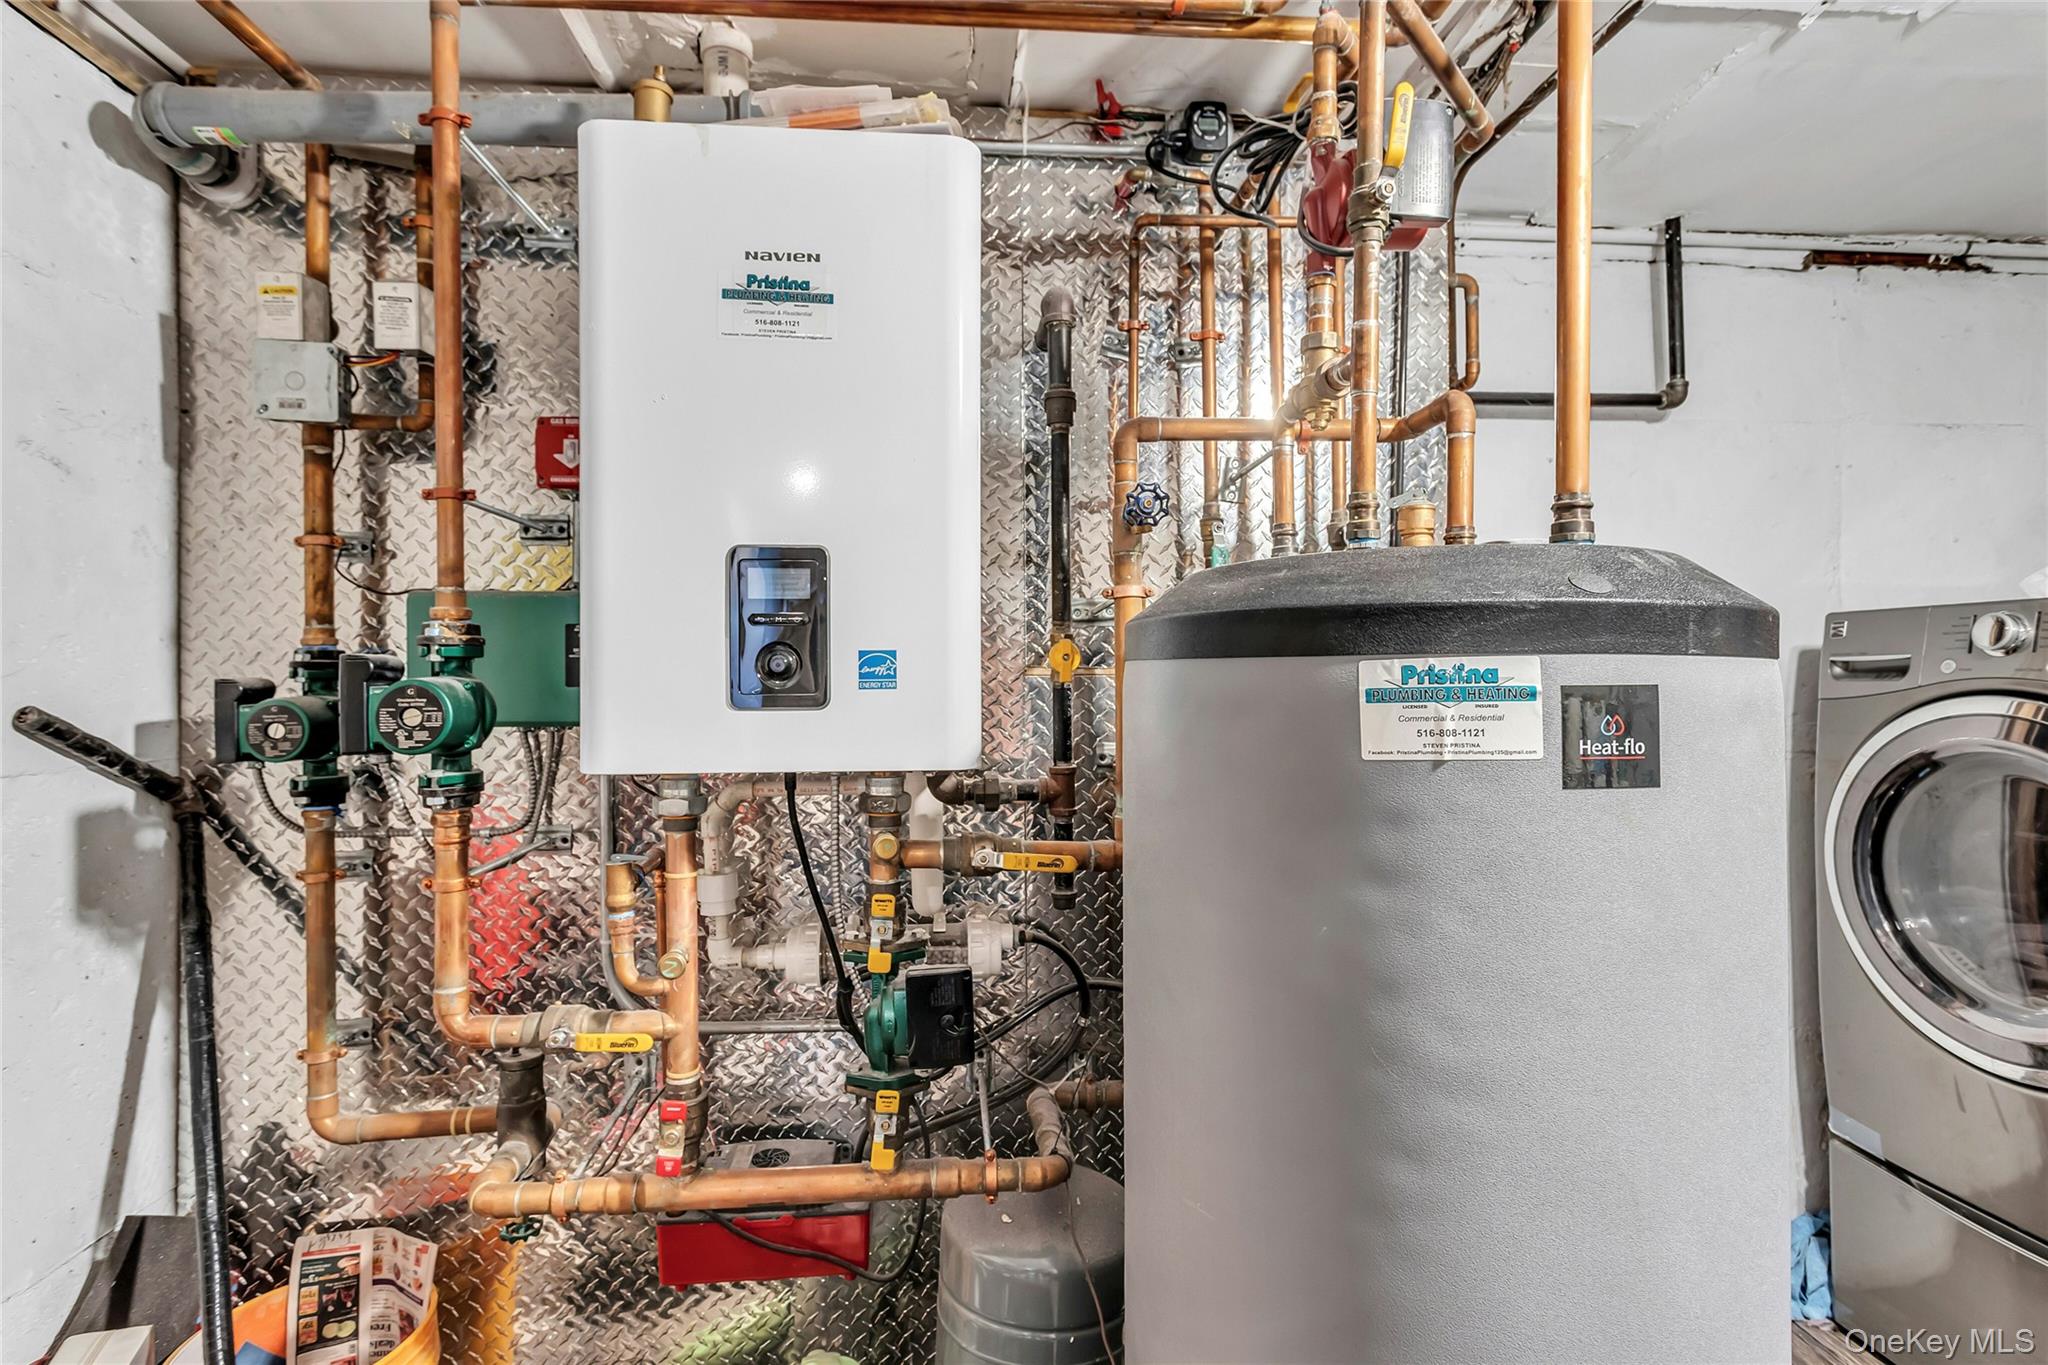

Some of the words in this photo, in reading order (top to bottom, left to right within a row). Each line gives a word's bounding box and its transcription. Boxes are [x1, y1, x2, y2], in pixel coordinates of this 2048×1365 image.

[746, 274, 811, 291] Pristina
[726, 290, 776, 301] PLUMBING
[778, 291, 787, 301] &
[789, 292, 831, 303] HEATING
[755, 319, 800, 327] 516-808-1121
[1401, 663, 1499, 685] Pristina
[881, 681, 897, 689] STAR
[1372, 688, 1446, 702] PLUMBING
[1451, 688, 1462, 701] &
[1467, 687, 1530, 701] HEATING
[1398, 714, 1448, 723] Commercial
[1450, 714, 1456, 722] &
[1458, 713, 1505, 722] Residential
[1416, 729, 1485, 738] 516-808-1121
[1579, 738, 1646, 755] Heat-flo
